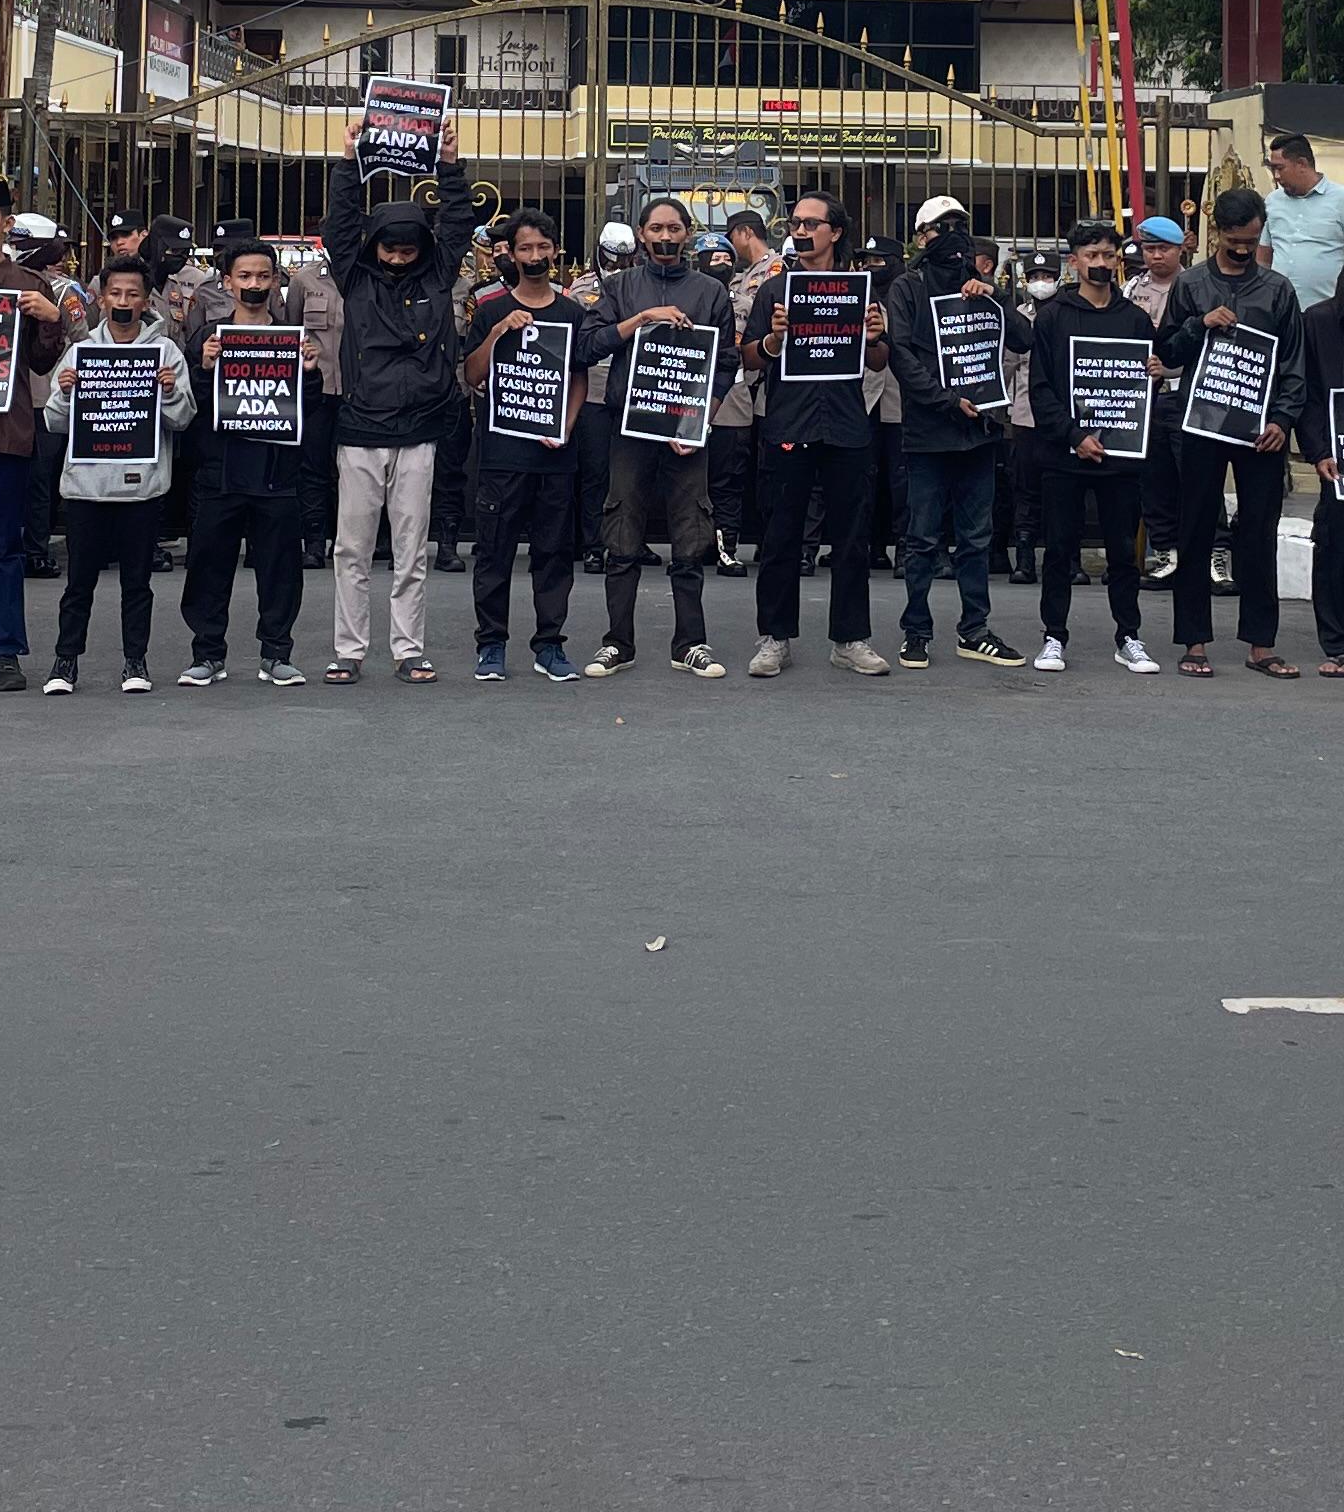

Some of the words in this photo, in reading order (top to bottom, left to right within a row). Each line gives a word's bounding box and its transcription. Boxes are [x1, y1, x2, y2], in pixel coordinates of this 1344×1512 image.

[480, 56, 554, 72] Harmoni
[368, 128, 429, 151] TANPA
[376, 148, 416, 159] ADA
[363, 156, 427, 171] TERSANGKA
[808, 281, 849, 293] HABIS
[793, 295, 805, 303] 03
[807, 295, 858, 304] NOVEMBER
[791, 323, 861, 336] TERBITLAH
[222, 335, 270, 344] MENOLAK
[274, 336, 298, 345] LUPA
[522, 326, 539, 349] P
[795, 338, 807, 346] 07
[809, 336, 851, 345] FEBRUARI
[516, 351, 542, 364] INFO
[809, 349, 834, 358] 2026
[224, 364, 250, 377] 100
[255, 365, 292, 377] HARI
[497, 363, 561, 381] TERSANGKA
[225, 380, 290, 396] TANPA
[499, 377, 533, 393] KASUS
[536, 384, 557, 396] OTT
[236, 399, 279, 416] ADA
[502, 392, 535, 407] SOLAR
[538, 398, 553, 410] 03
[498, 405, 554, 425] NOVEMBER
[222, 420, 292, 431] TERSANGKA
